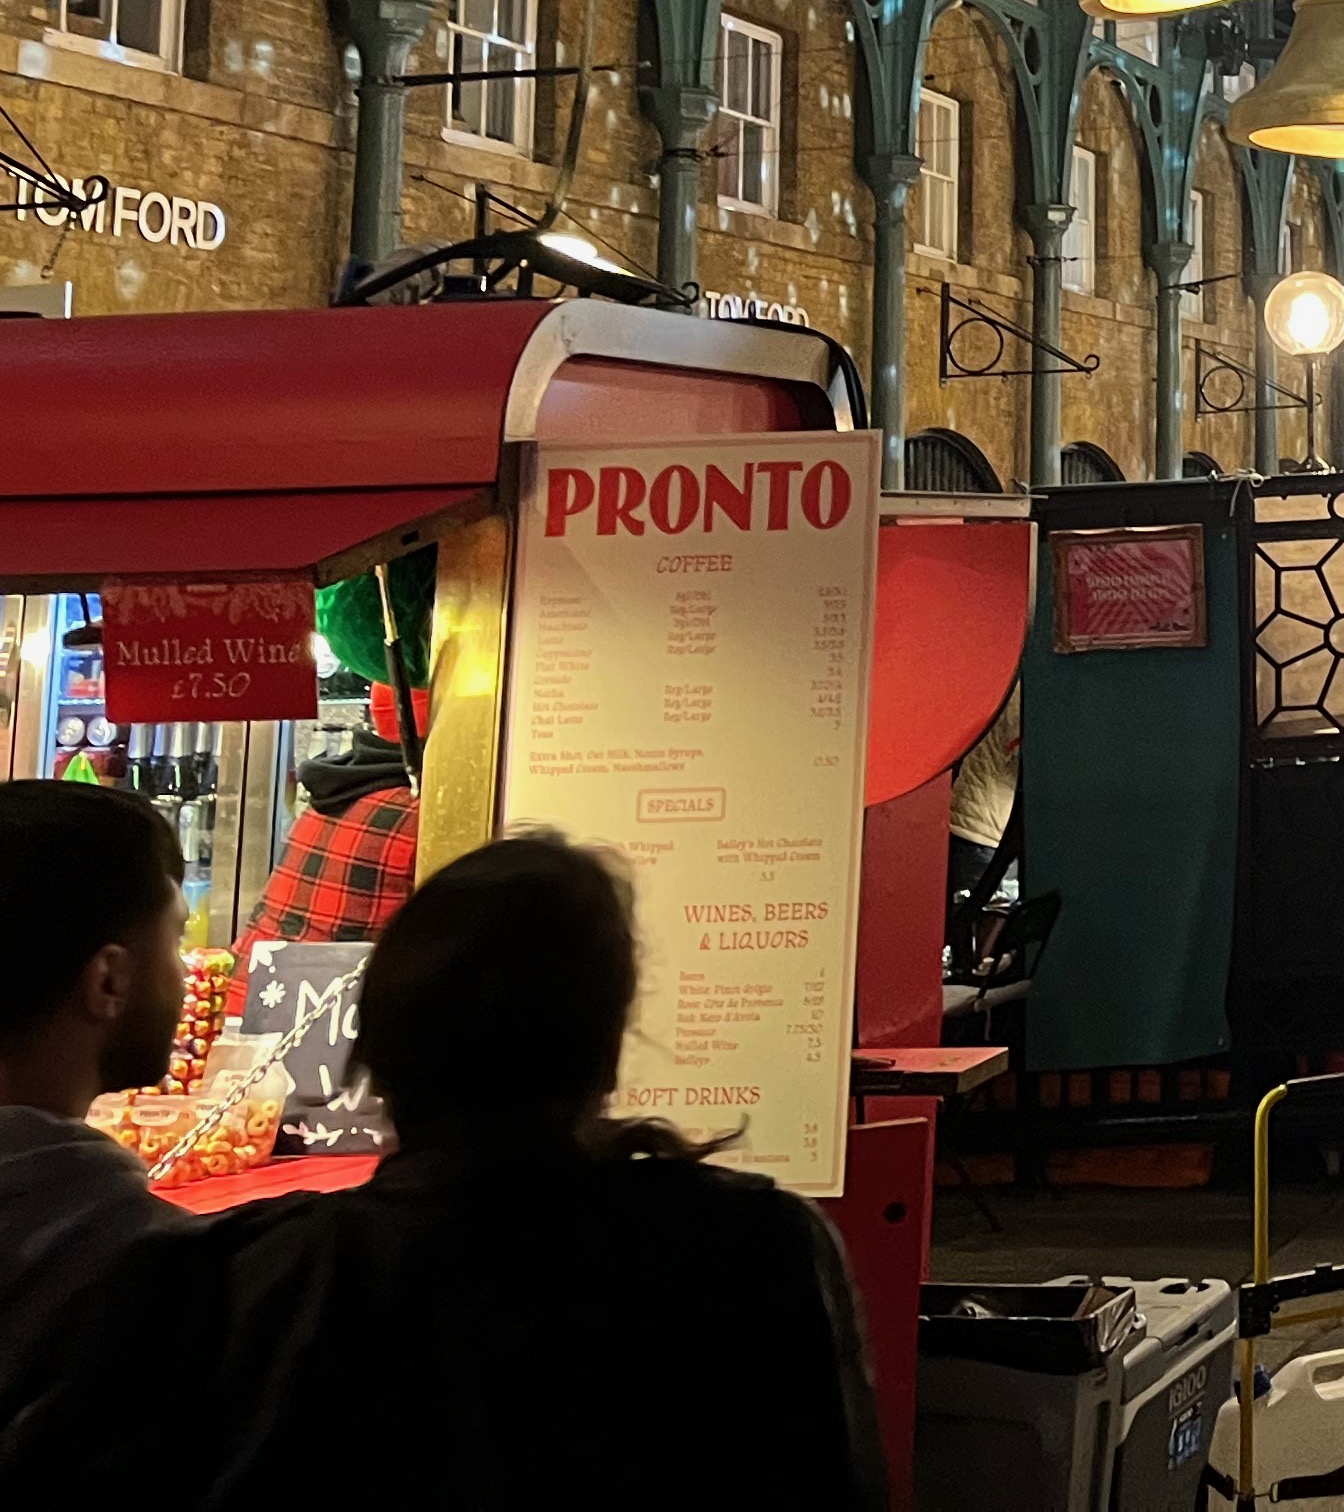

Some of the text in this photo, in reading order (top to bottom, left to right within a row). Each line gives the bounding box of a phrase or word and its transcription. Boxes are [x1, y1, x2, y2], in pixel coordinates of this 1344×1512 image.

[8, 172, 226, 251] TOM FORD
[544, 460, 852, 538] PRONTO
[656, 554, 733, 573] COFFEE
[115, 637, 303, 666] Mulled Wine
[171, 671, 253, 699] £7.50
[647, 797, 716, 815] SPECIALS
[764, 901, 829, 922] BEERS
[699, 929, 809, 952] & LIQUORS
[627, 1086, 761, 1106] SOFT DRINKS
